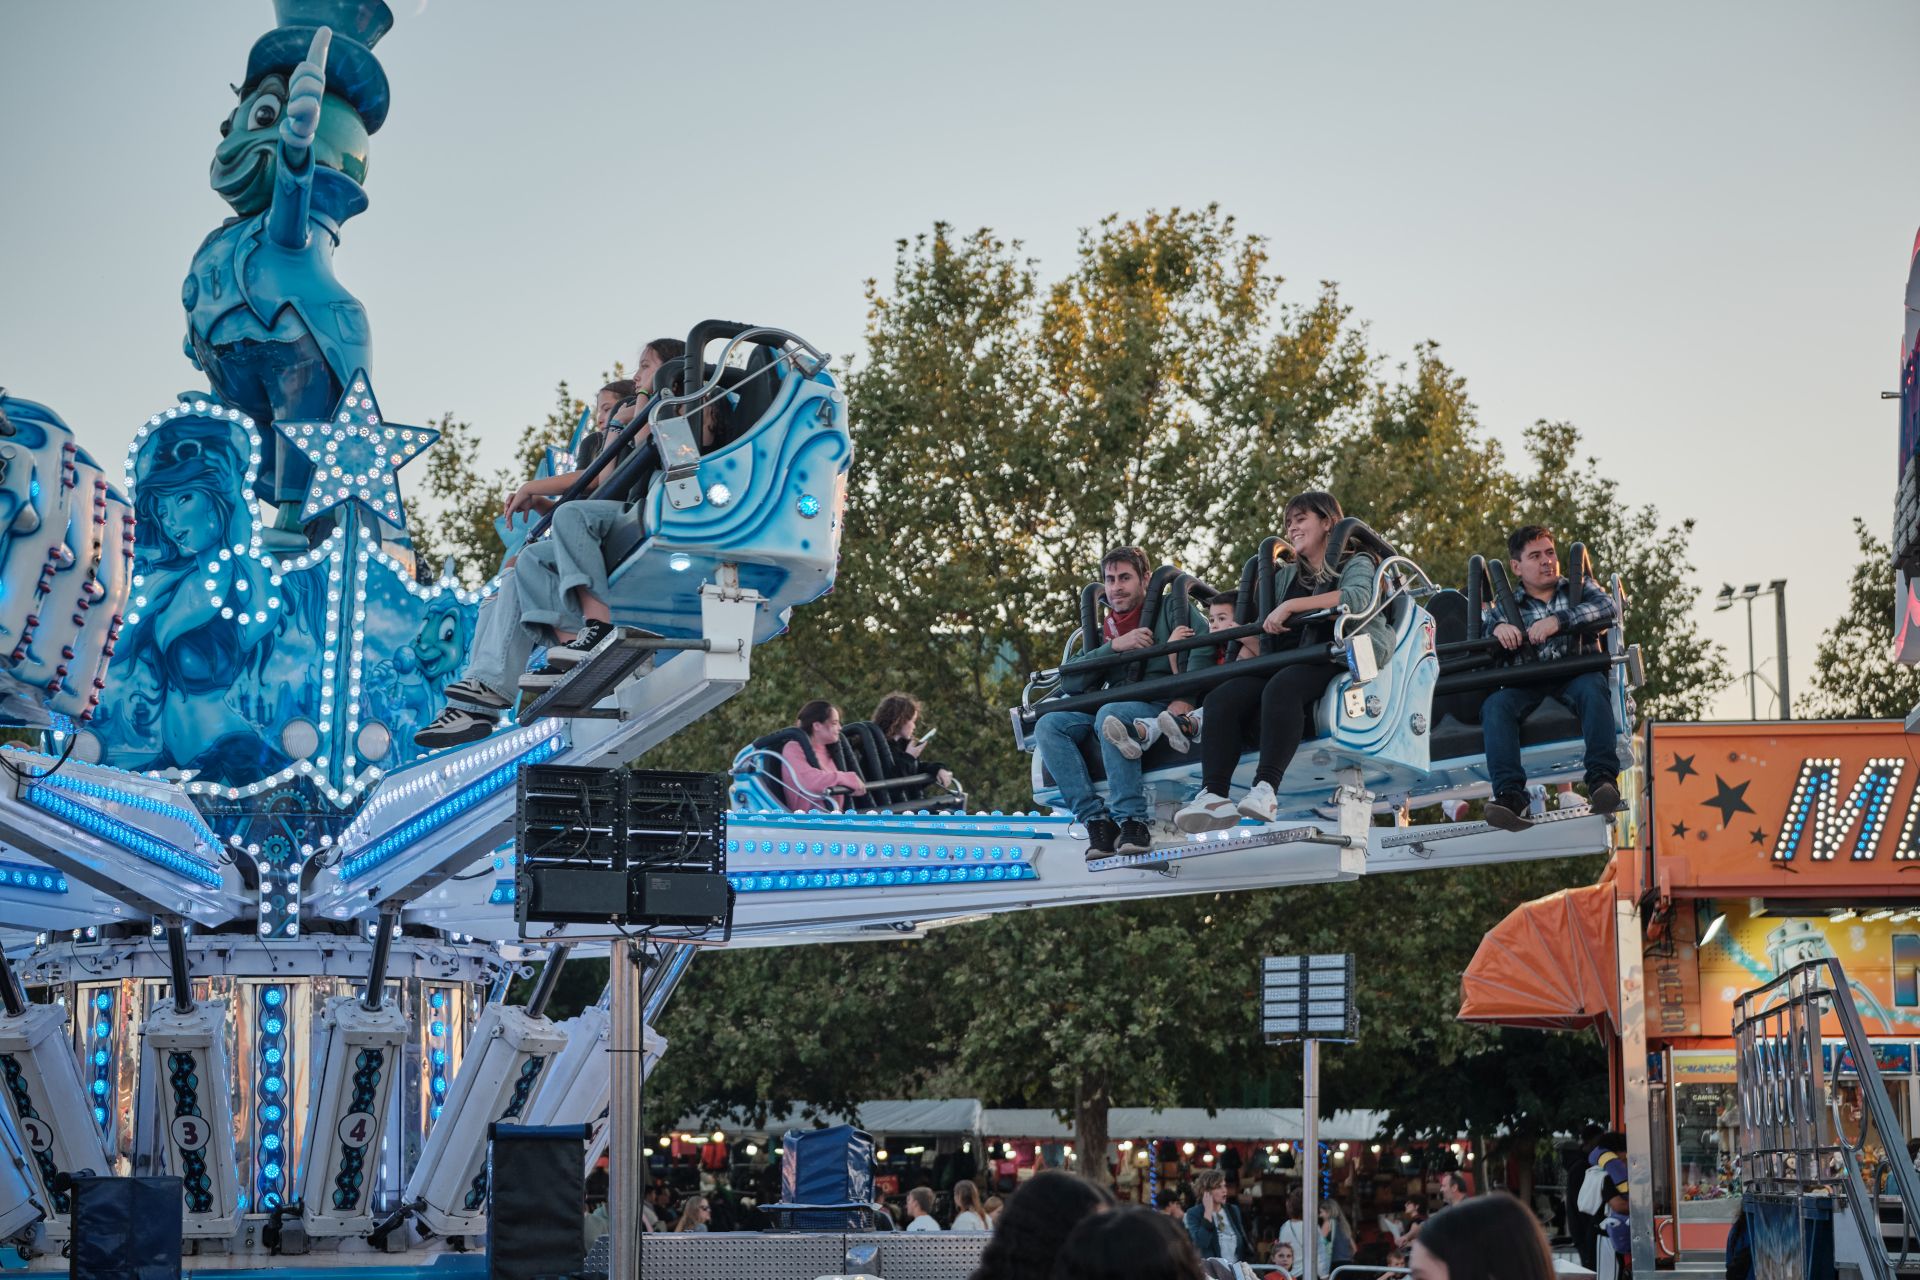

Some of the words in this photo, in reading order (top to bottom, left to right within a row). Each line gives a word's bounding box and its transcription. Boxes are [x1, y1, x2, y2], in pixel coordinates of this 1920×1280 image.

[815, 399, 833, 427] 4
[1770, 757, 1920, 861] M
[25, 1123, 44, 1146] 2
[182, 1122, 198, 1145] 3
[349, 1118, 367, 1142] 4
